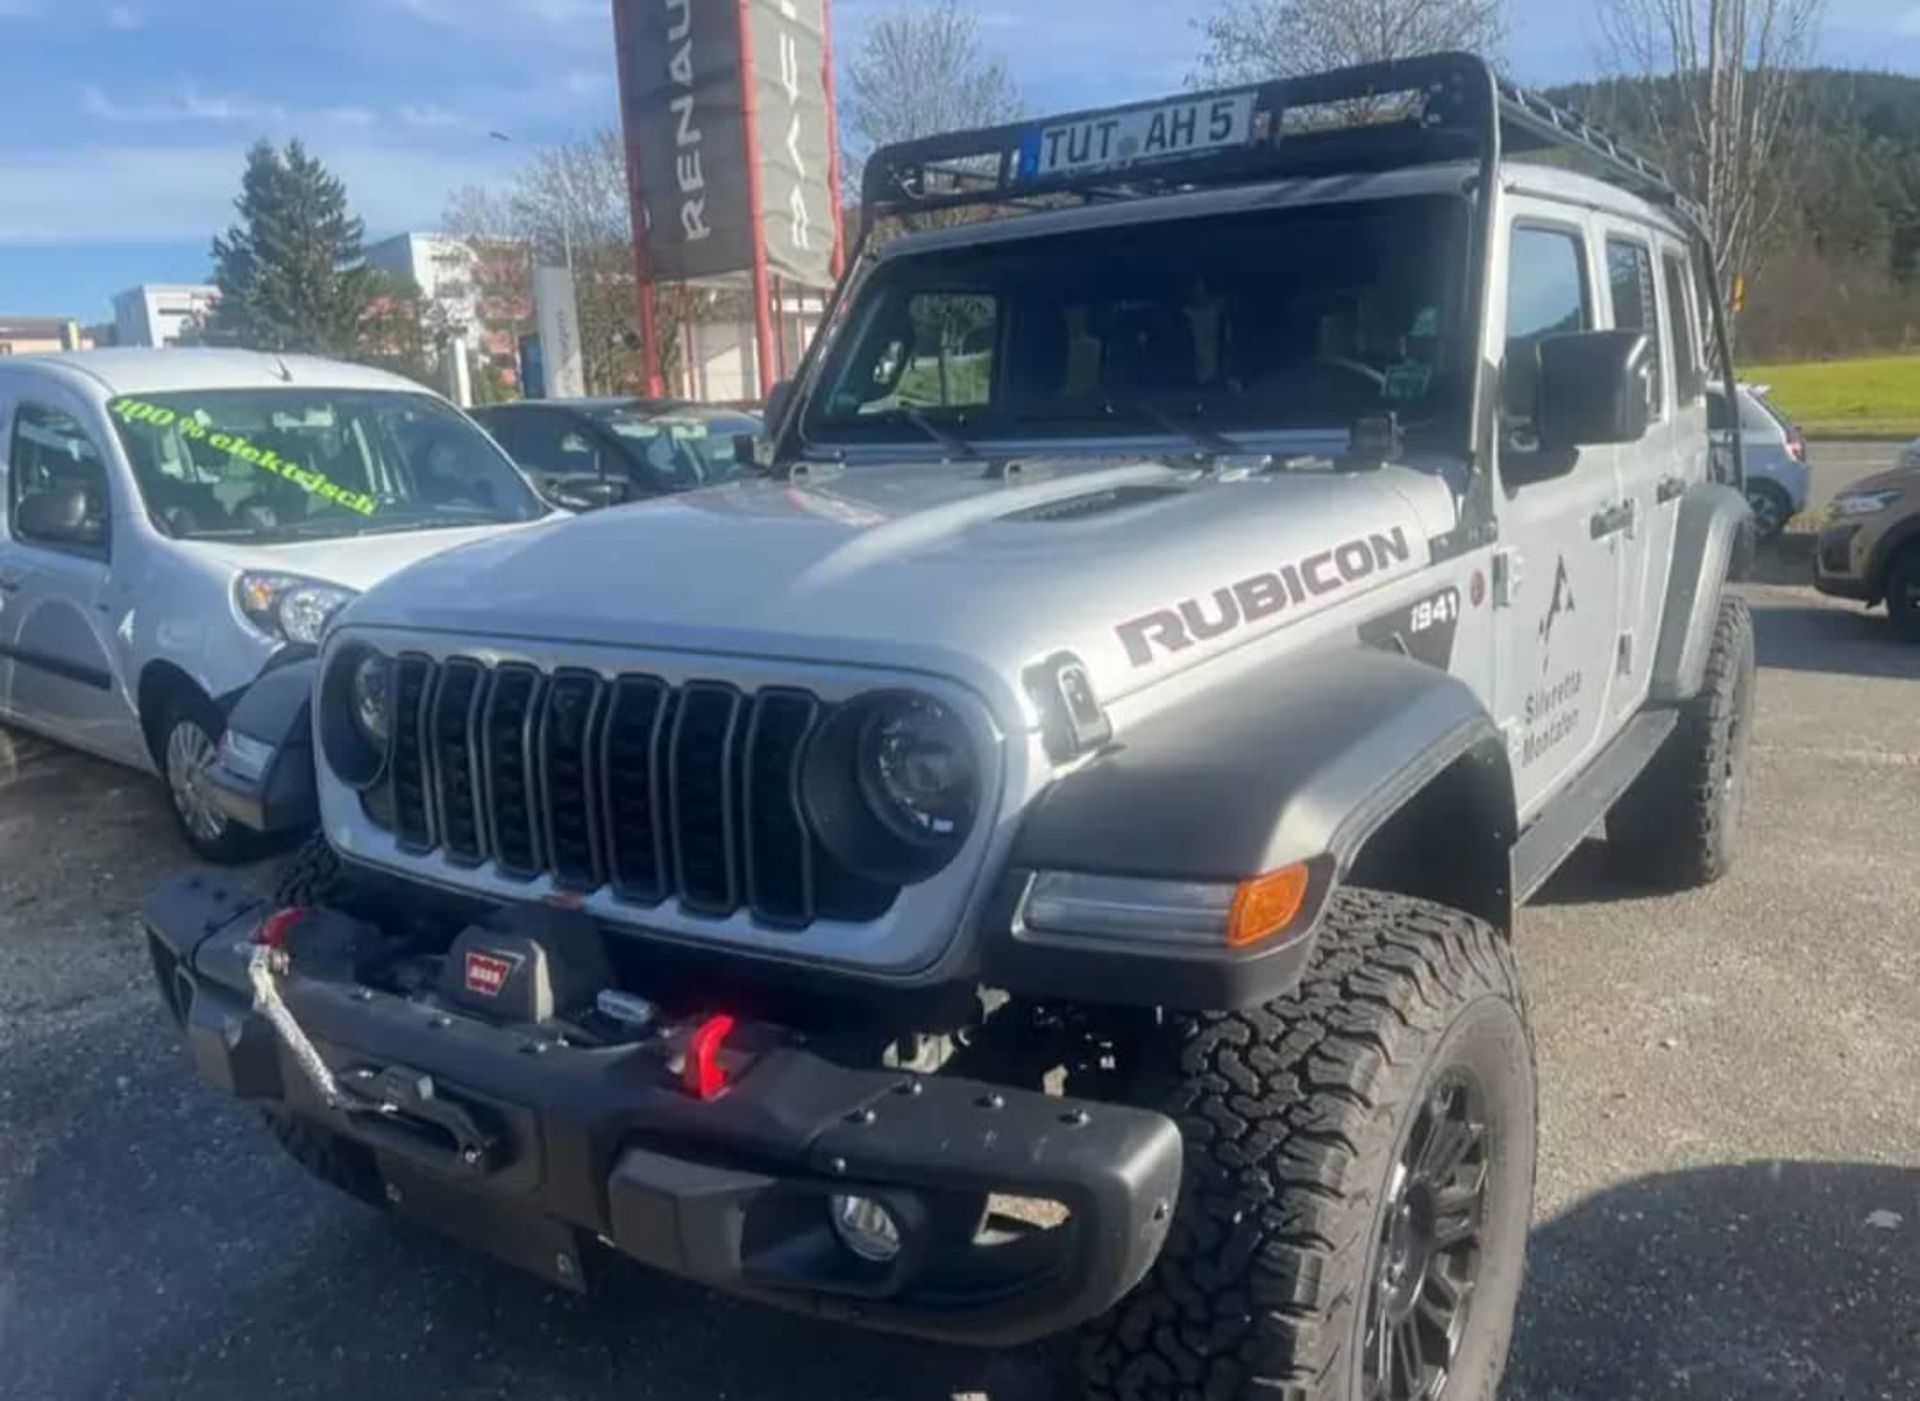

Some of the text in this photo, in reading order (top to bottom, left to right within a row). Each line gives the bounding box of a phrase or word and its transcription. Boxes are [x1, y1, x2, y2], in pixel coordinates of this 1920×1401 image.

[1045, 101, 1235, 167] TUT AH 5
[115, 398, 174, 426] 100
[178, 416, 206, 438] %
[1114, 526, 1409, 668] RUBICON
[1410, 594, 1457, 633] 1941
